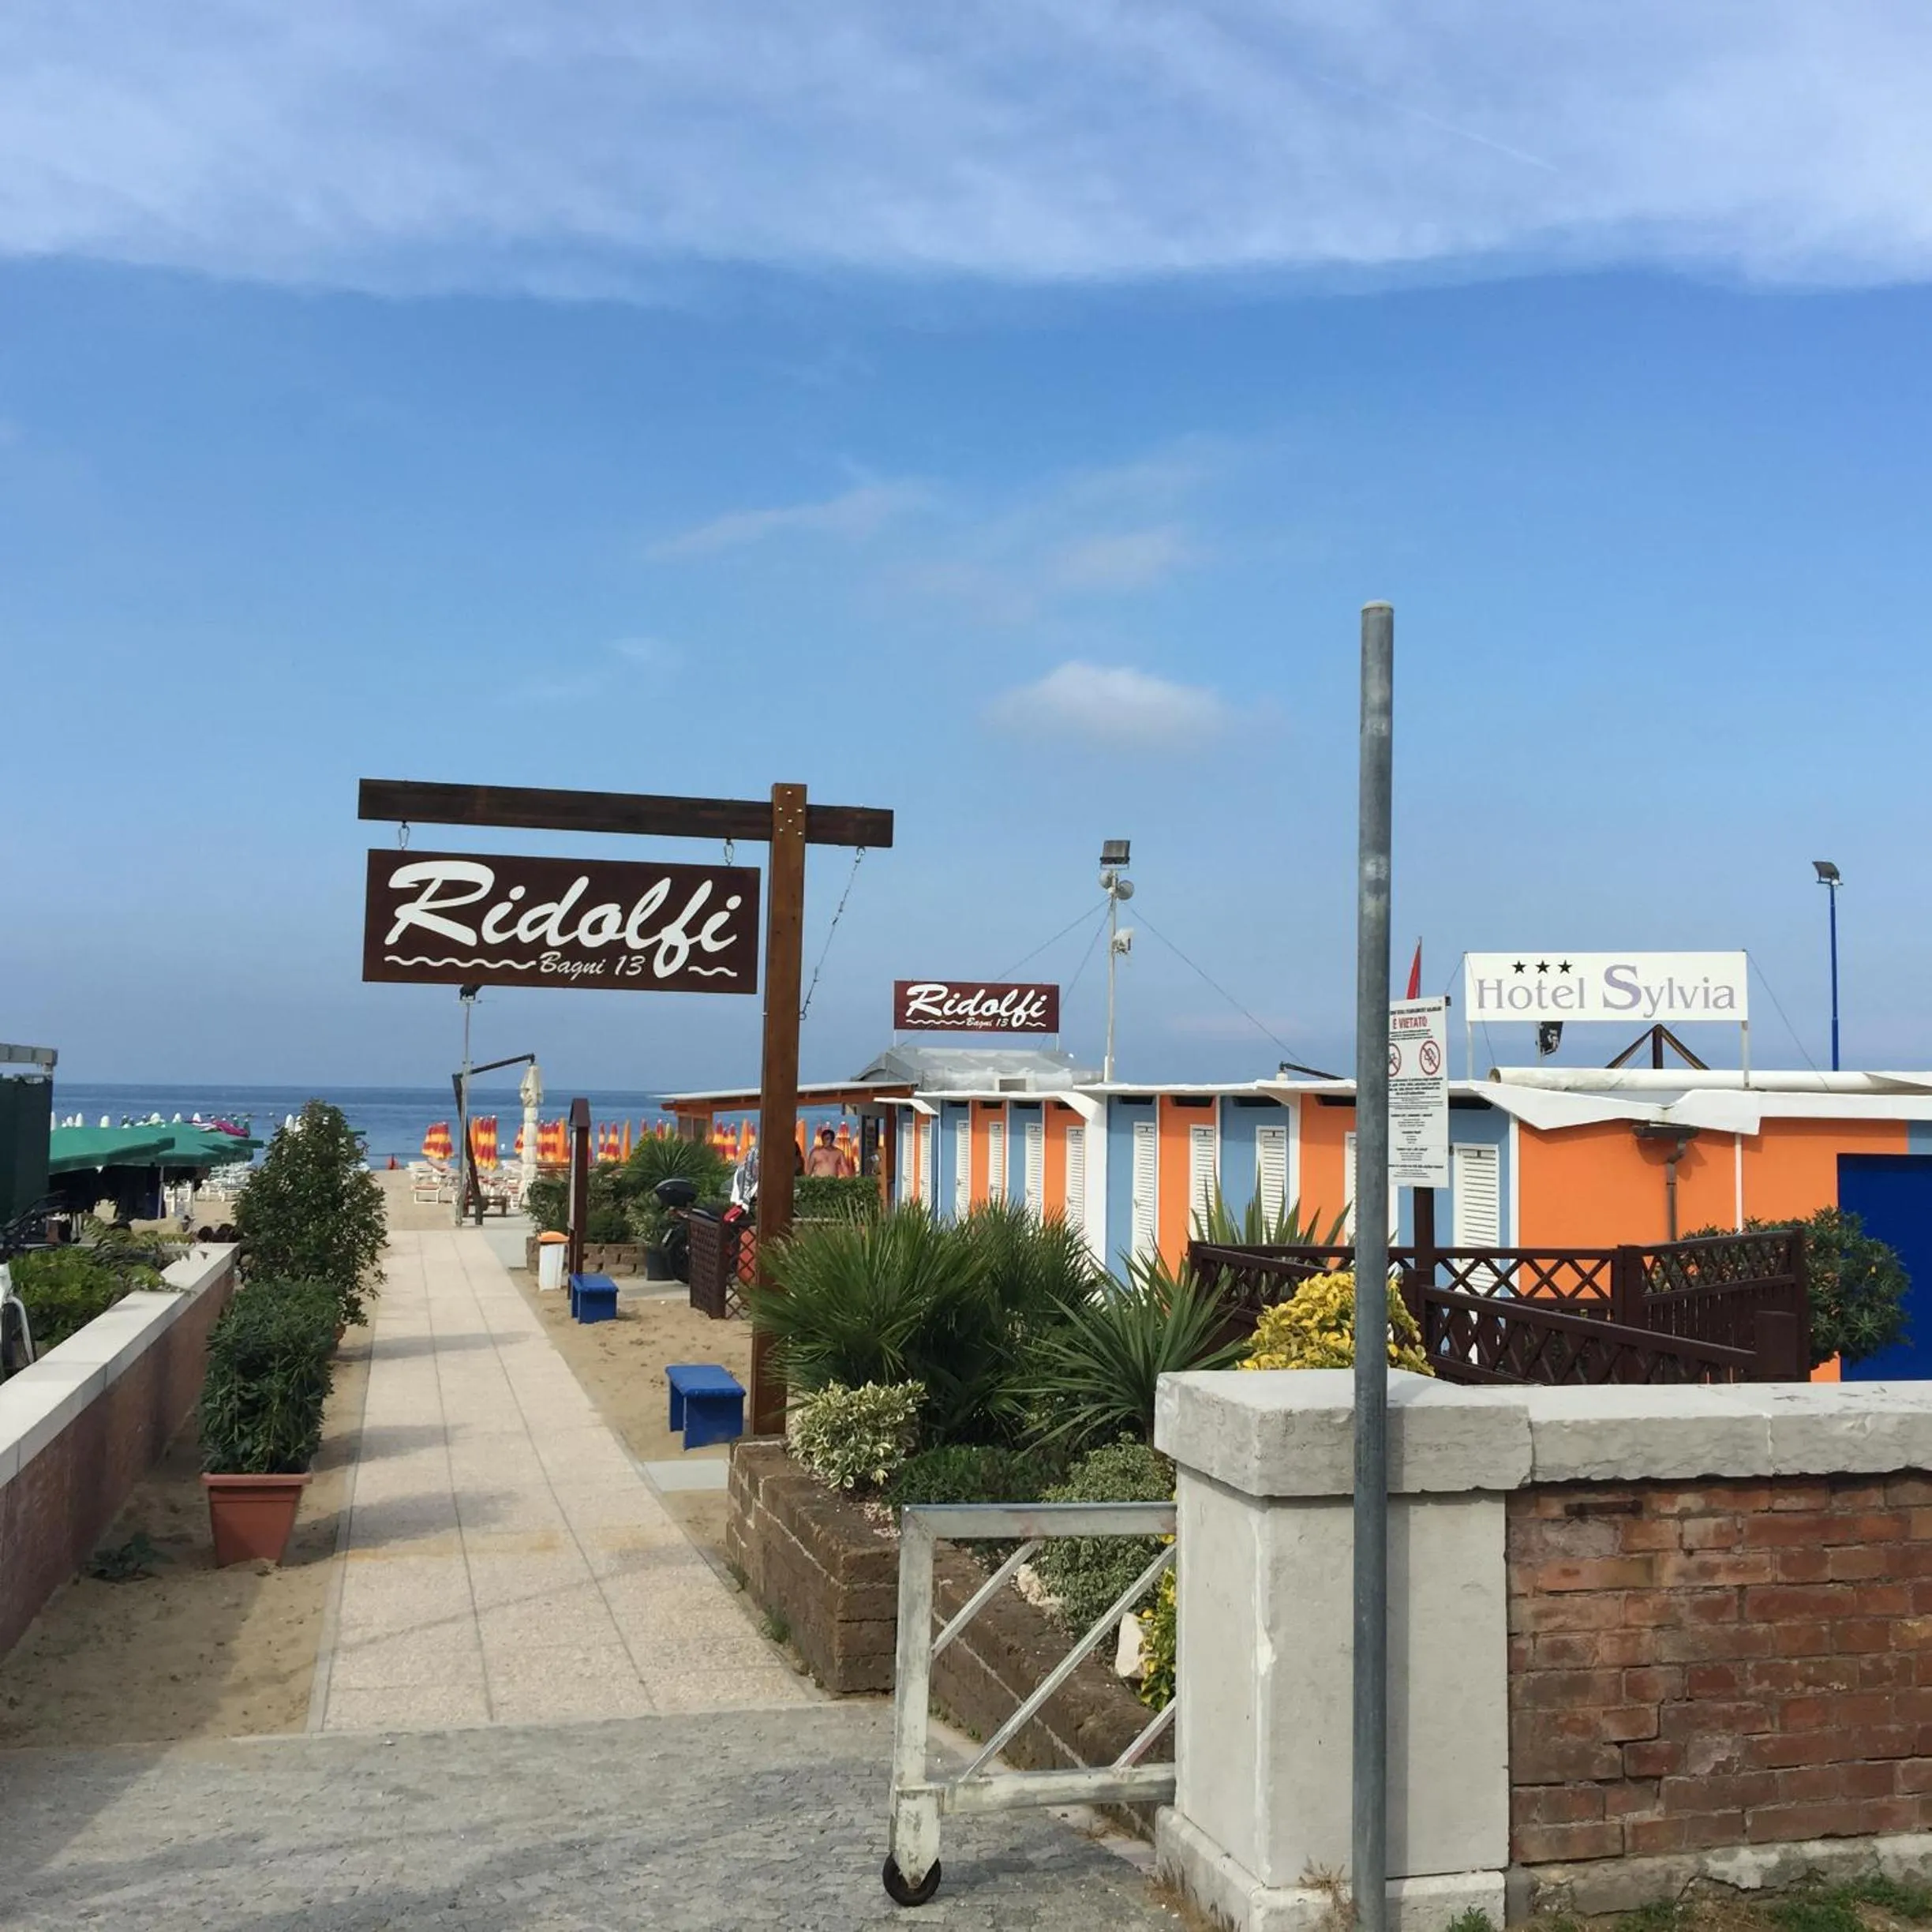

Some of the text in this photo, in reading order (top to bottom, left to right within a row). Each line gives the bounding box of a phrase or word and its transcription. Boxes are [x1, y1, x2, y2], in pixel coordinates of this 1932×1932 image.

[384, 860, 742, 979] Ridolfi
[538, 952, 646, 981] Bagni 13
[905, 983, 1047, 1028] Ridolfi
[1477, 964, 1736, 1019] Hotel Sylvia
[965, 1017, 1009, 1028] Bagni 13
[1398, 1016, 1428, 1029] VIETATO
